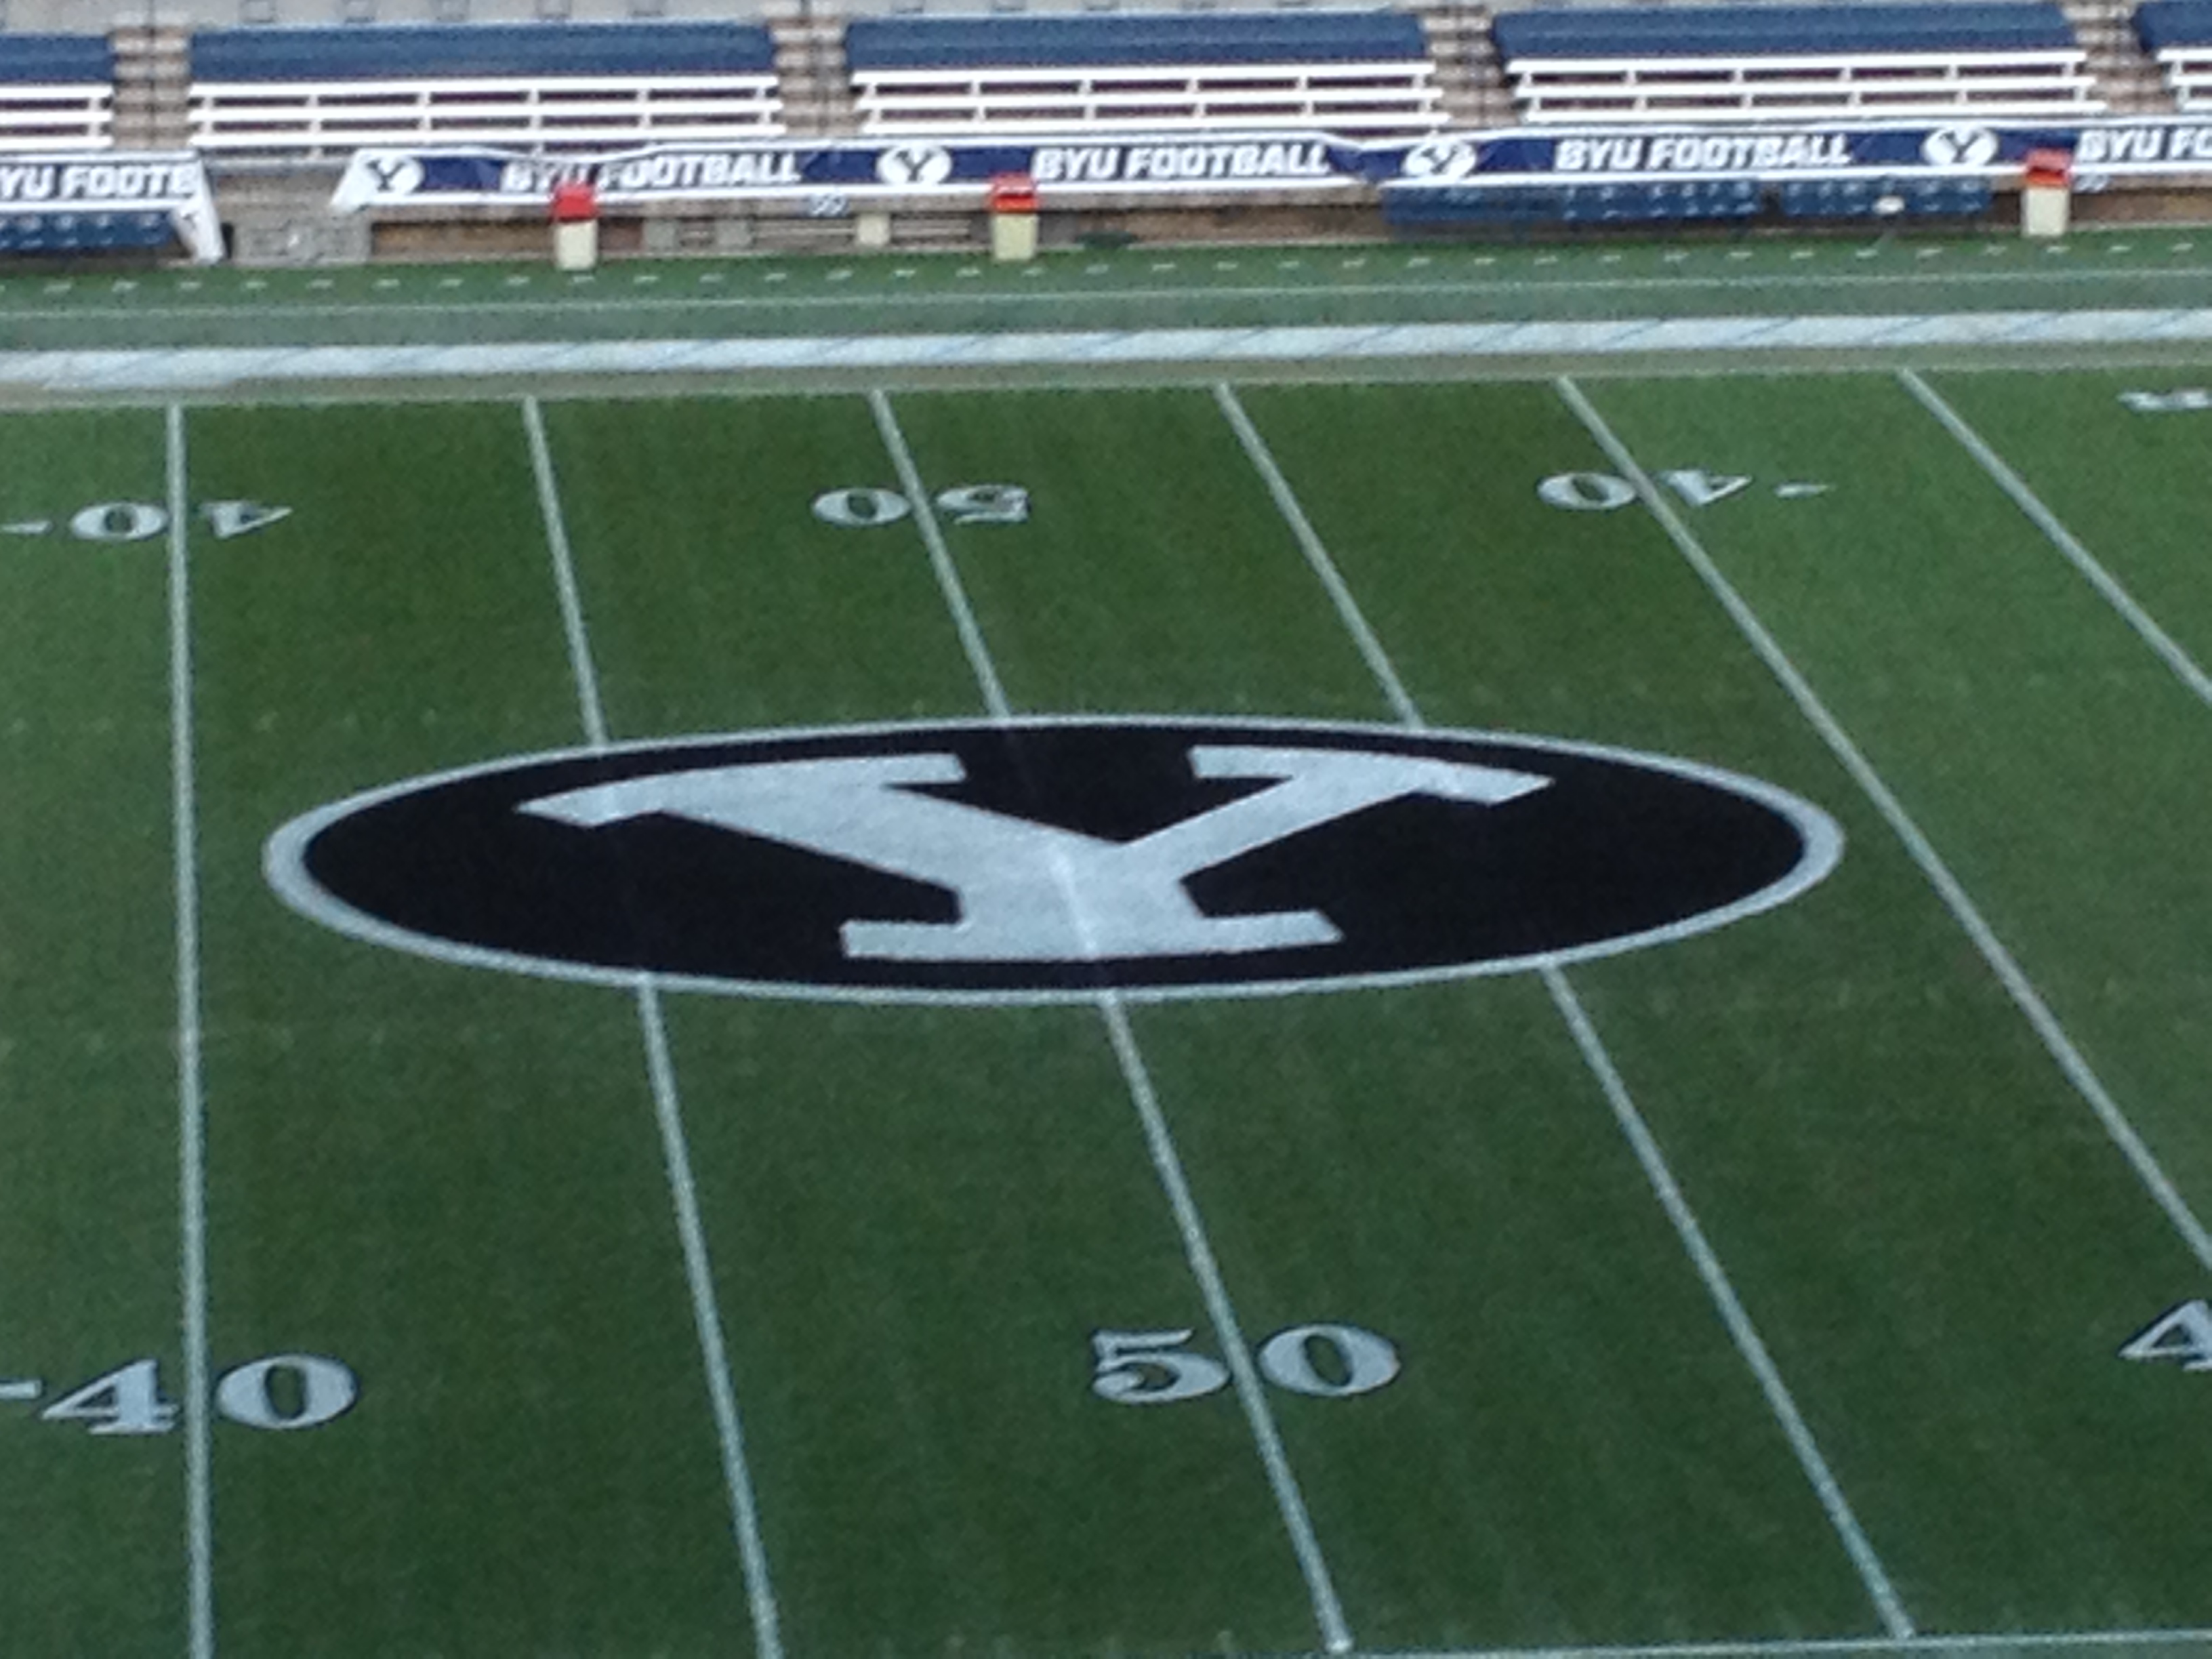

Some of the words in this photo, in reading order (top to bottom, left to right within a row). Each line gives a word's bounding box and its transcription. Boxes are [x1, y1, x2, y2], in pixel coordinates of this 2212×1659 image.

[1031, 147, 1120, 180] BYU
[1124, 141, 1331, 178] FOOTBALL
[1555, 138, 1645, 171] BYU
[1647, 133, 1851, 170] FOOTBALL
[2079, 129, 2162, 161] BYU
[0, 167, 52, 198] YU
[601, 152, 802, 189] FOOTBALL
[515, 745, 1553, 961] Y
[1092, 1324, 1400, 1403] 50
[42, 1355, 356, 1434] 40
